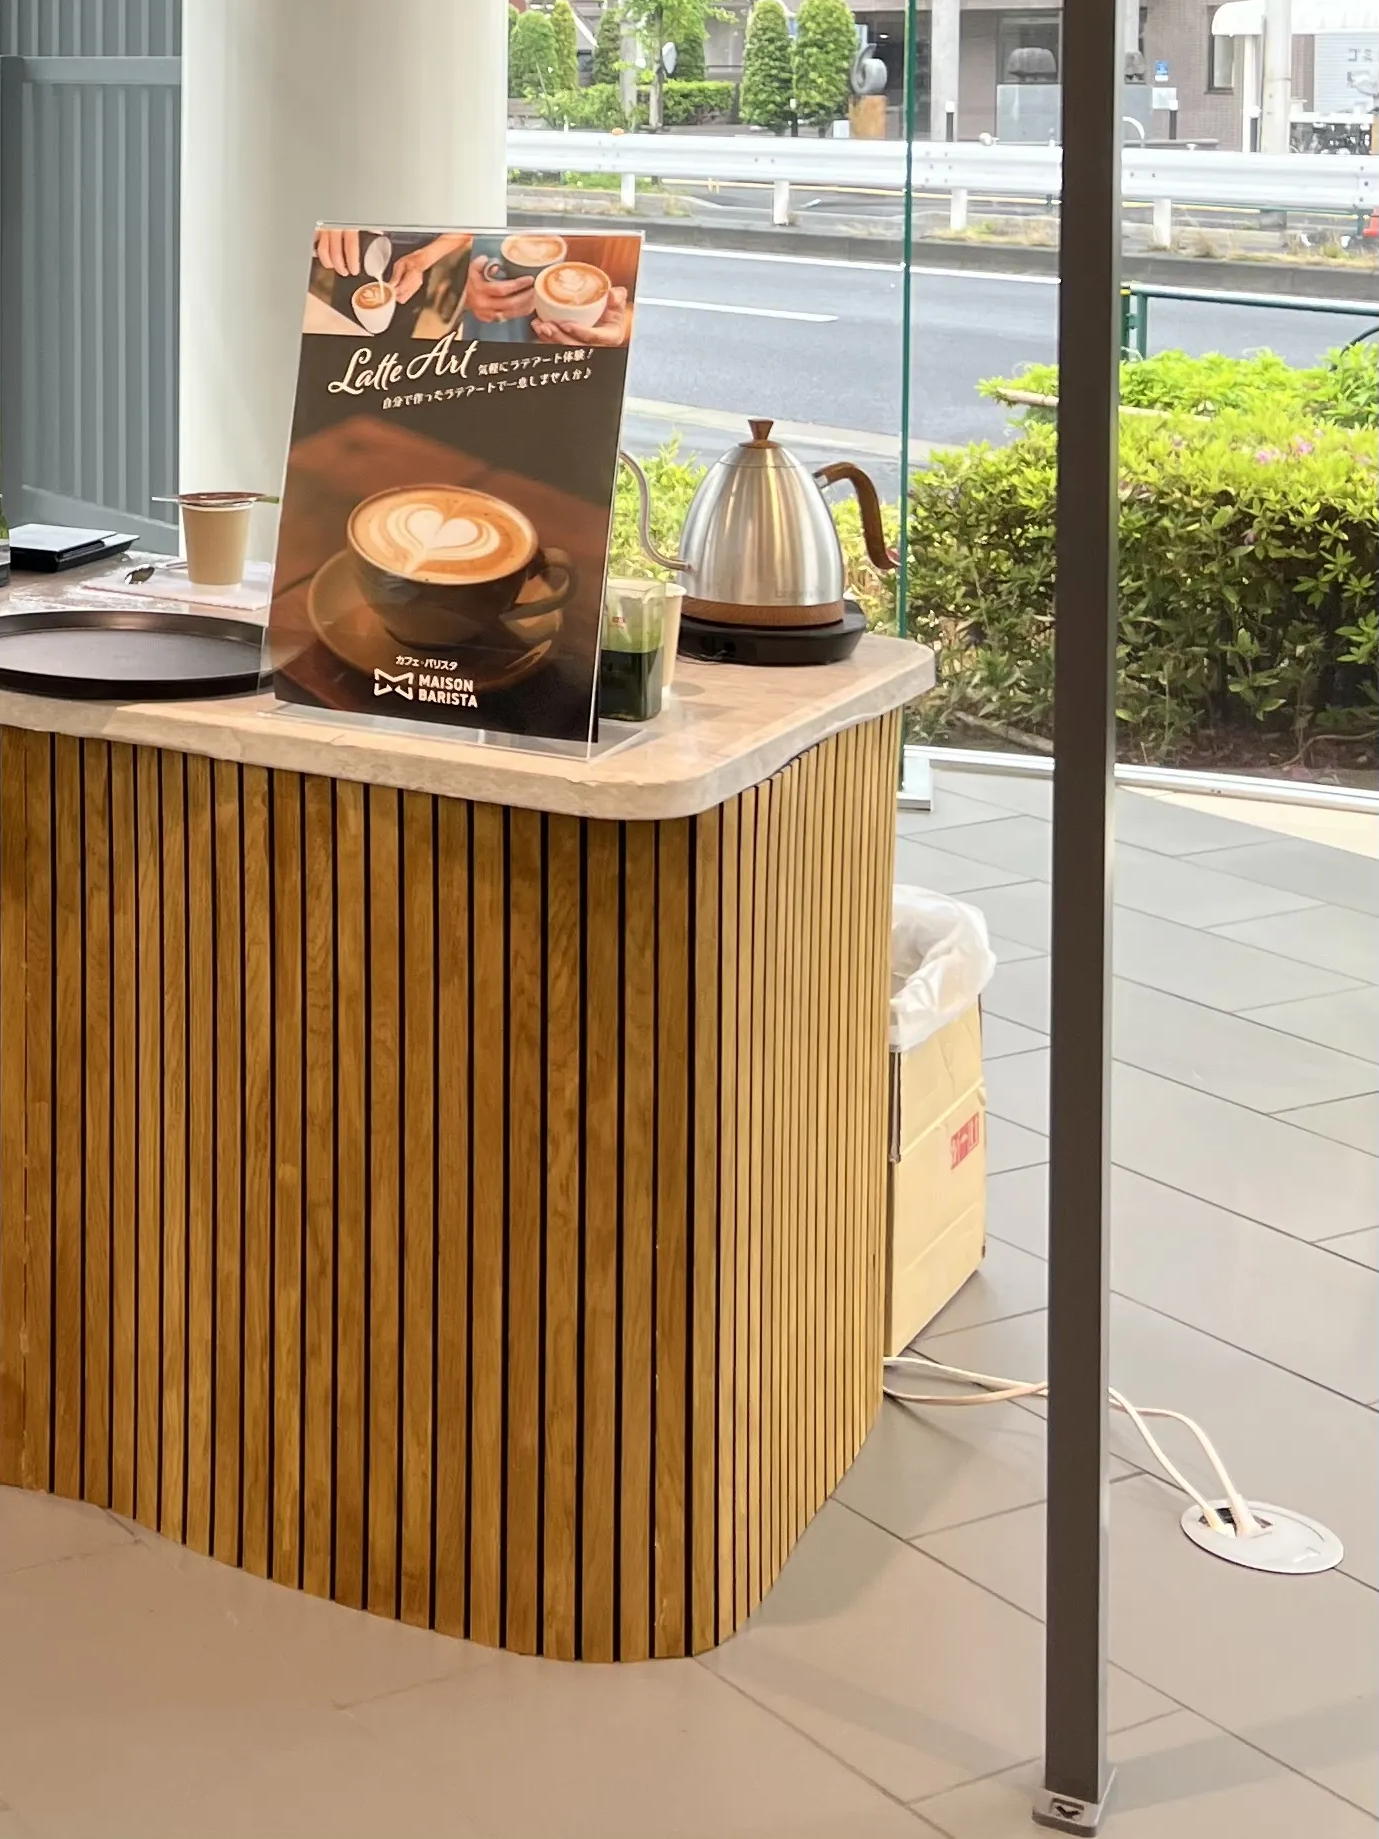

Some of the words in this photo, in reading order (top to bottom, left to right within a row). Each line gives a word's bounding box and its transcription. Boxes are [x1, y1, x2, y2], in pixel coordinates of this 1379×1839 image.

[327, 347, 402, 395] Latte
[406, 331, 479, 379] Art
[418, 673, 474, 693] MAISON
[418, 688, 479, 709] BARISTA
